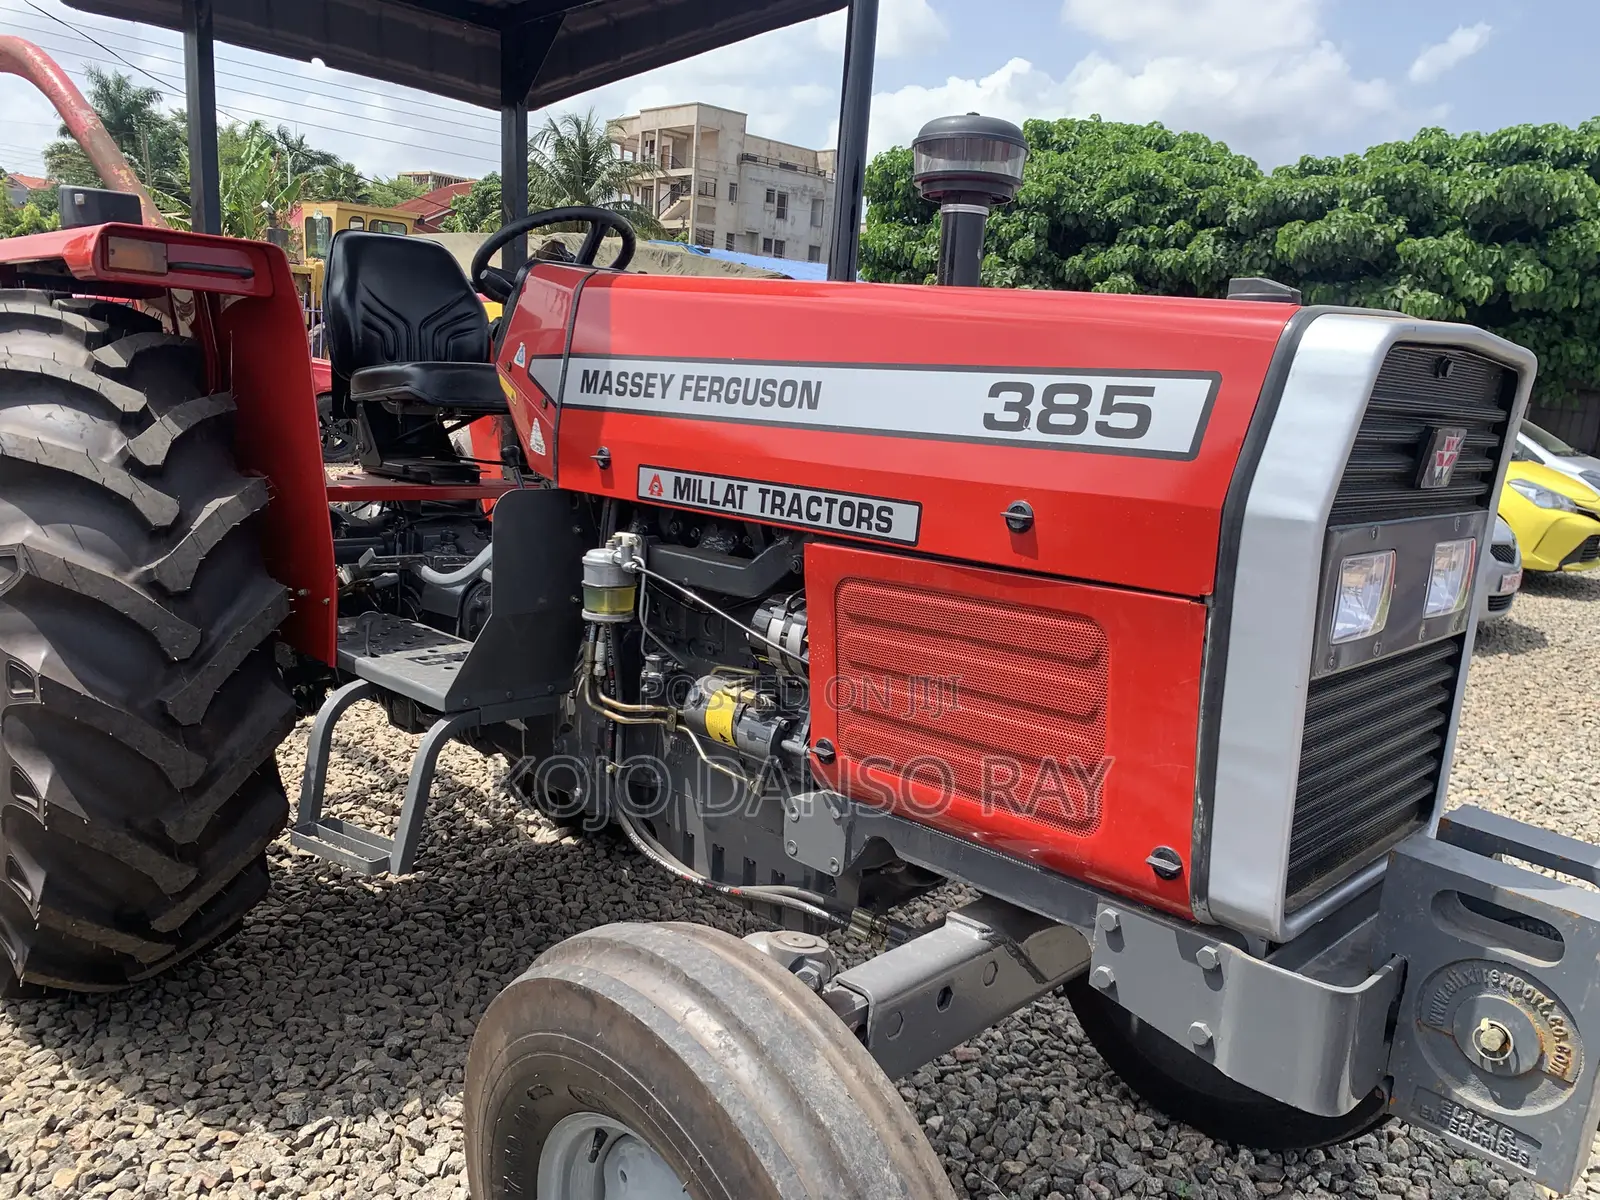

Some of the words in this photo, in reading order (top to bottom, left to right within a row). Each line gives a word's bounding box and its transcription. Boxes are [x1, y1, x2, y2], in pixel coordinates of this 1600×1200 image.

[580, 369, 675, 400] MASSEY
[679, 375, 822, 410] FERGUSON
[983, 381, 1156, 440] 385
[673, 476, 748, 510] MILLAT
[758, 488, 895, 534] TRACTORS
[1419, 1104, 1531, 1170] ENTERPRISES
[1440, 1099, 1517, 1147] ELIXIR
